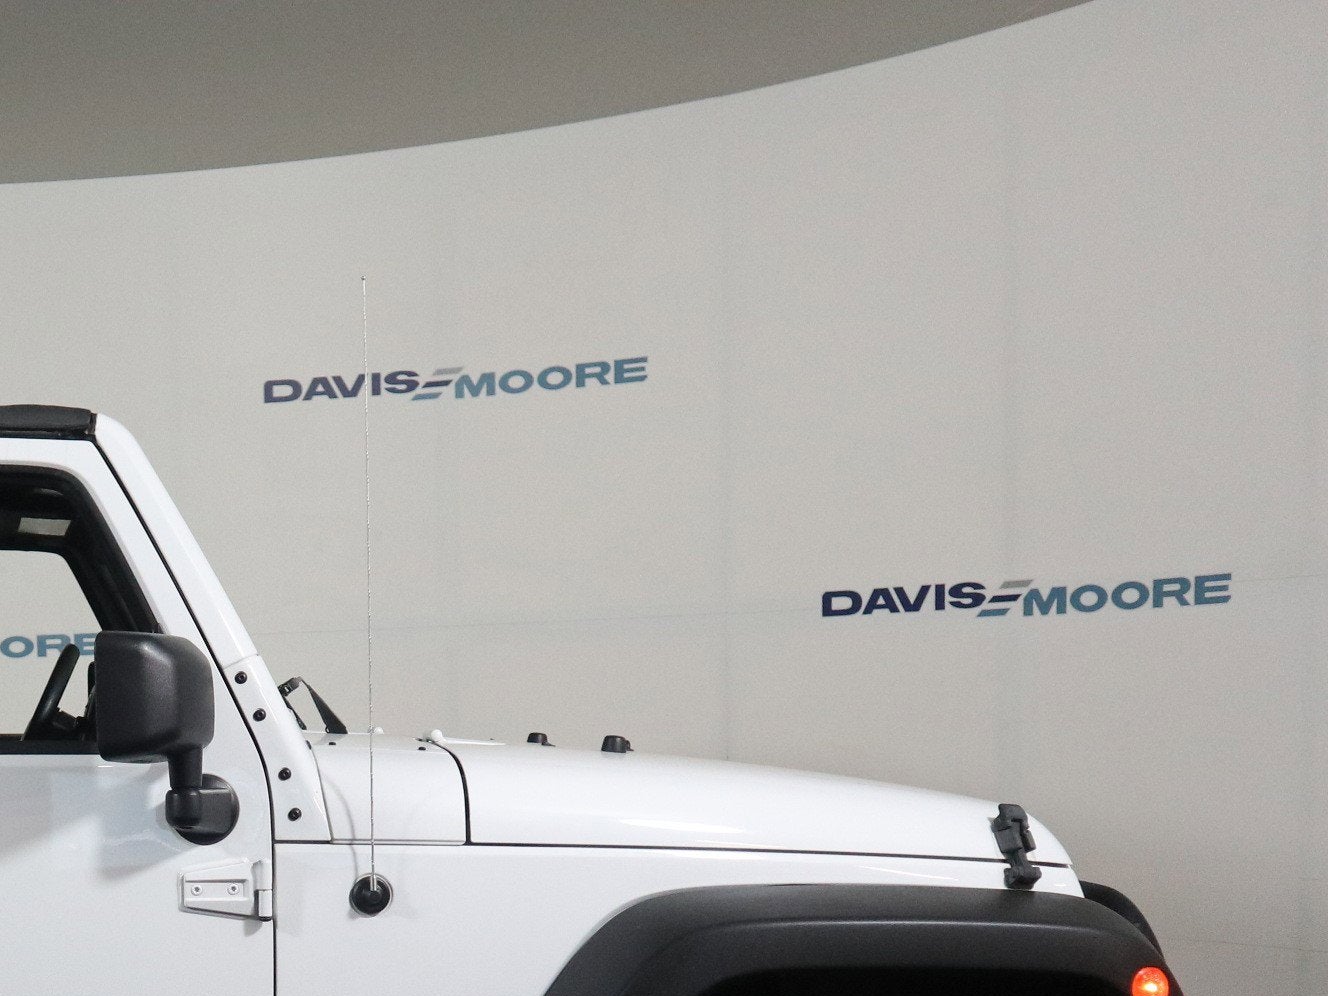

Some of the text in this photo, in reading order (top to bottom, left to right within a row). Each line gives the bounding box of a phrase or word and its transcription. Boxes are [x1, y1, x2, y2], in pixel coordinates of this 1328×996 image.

[263, 356, 649, 403] DAVIS MOORE
[821, 573, 1233, 617] DAVIS MOORE
